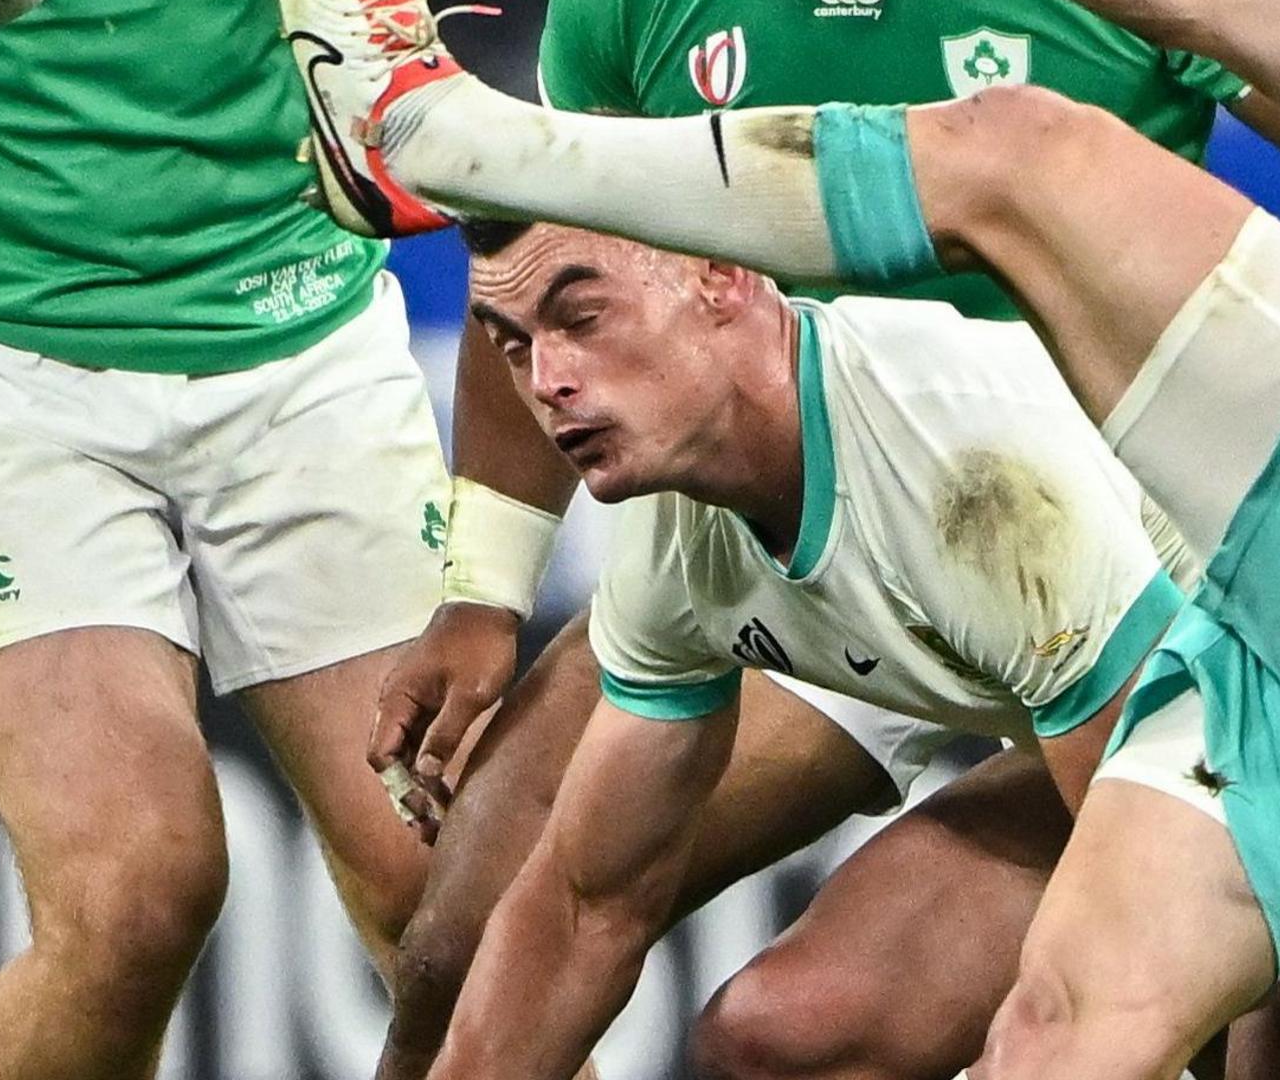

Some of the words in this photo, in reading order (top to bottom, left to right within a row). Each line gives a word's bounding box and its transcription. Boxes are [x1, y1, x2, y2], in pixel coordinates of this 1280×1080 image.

[813, 4, 883, 20] canterbury
[235, 272, 268, 295] JOSH
[270, 263, 297, 282] VAN
[271, 275, 297, 295] CAP
[253, 291, 295, 315] SOUTH
[300, 273, 345, 301] AFRICA
